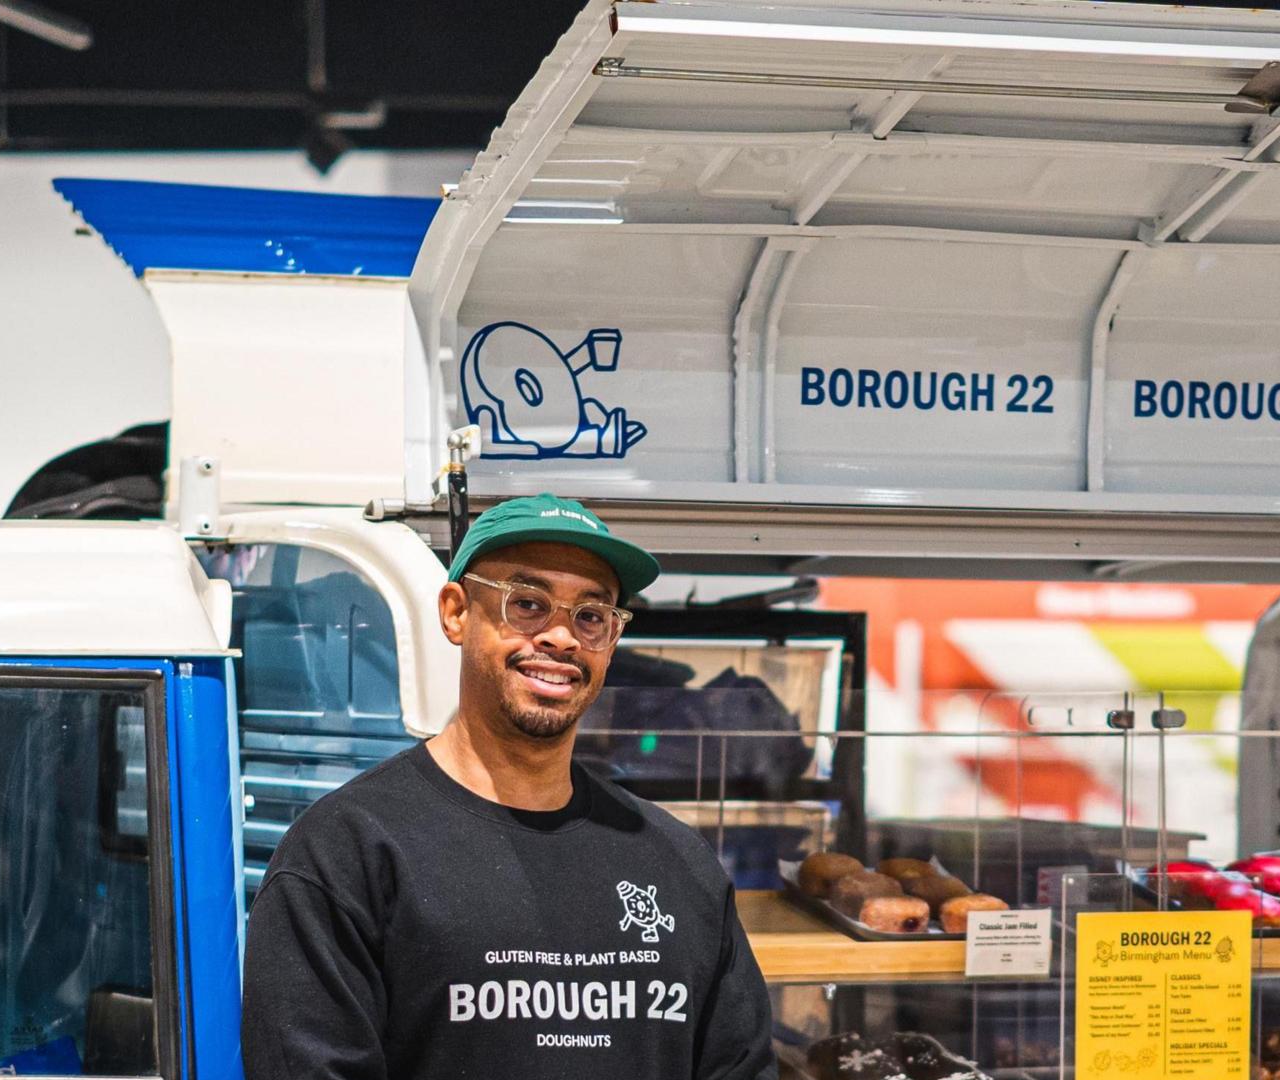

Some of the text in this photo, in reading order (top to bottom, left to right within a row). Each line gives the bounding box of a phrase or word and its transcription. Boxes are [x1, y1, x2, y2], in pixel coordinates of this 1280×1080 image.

[800, 366, 1054, 414] BOROUGH 22
[1019, 922, 1038, 930] Filled
[1121, 931, 1211, 947] BOROUGH 22
[485, 950, 661, 967] GLUTEN FREE & PLANT BASED
[1120, 949, 1212, 964] Birmingham Menu
[449, 979, 688, 1023] BOROUGH 22
[536, 1033, 612, 1048] DOUGHNUTS
[1198, 1041, 1228, 1049] SPECIALS
